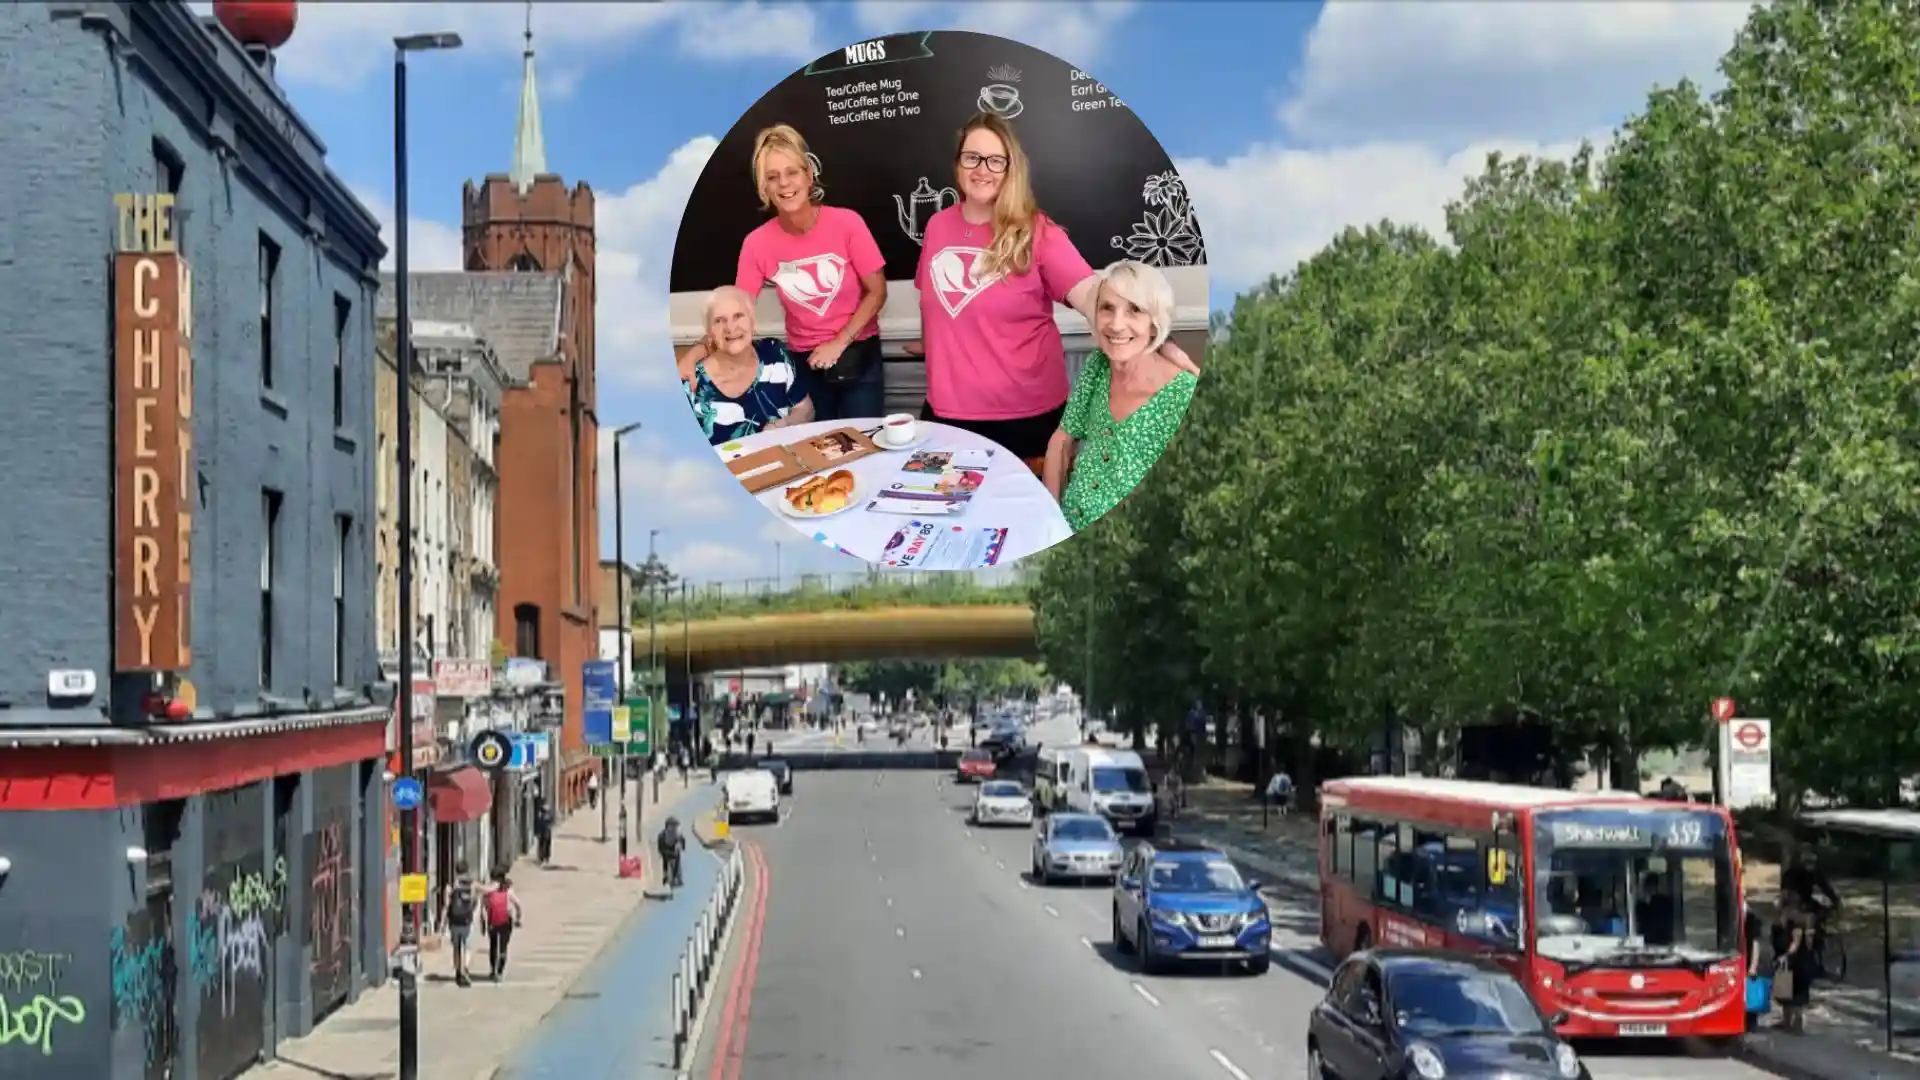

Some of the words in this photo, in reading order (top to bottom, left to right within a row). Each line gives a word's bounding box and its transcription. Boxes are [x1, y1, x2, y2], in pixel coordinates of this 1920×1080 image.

[845, 40, 886, 65] MUGS
[825, 81, 877, 98] Tea/Coffee
[880, 79, 902, 91] Mug
[1071, 83, 1093, 96] Earl
[827, 95, 879, 112] Tea/Coffee
[881, 92, 895, 104] for
[897, 91, 920, 102] One
[1071, 100, 1106, 112] Green
[829, 109, 881, 125] Tea/Coffee
[882, 107, 896, 118] for
[899, 105, 921, 117] Two
[114, 193, 175, 252] THE
[133, 257, 161, 667] CHERRY
[177, 260, 192, 668] HOTEL
[1564, 825, 1640, 842] Shadwell
